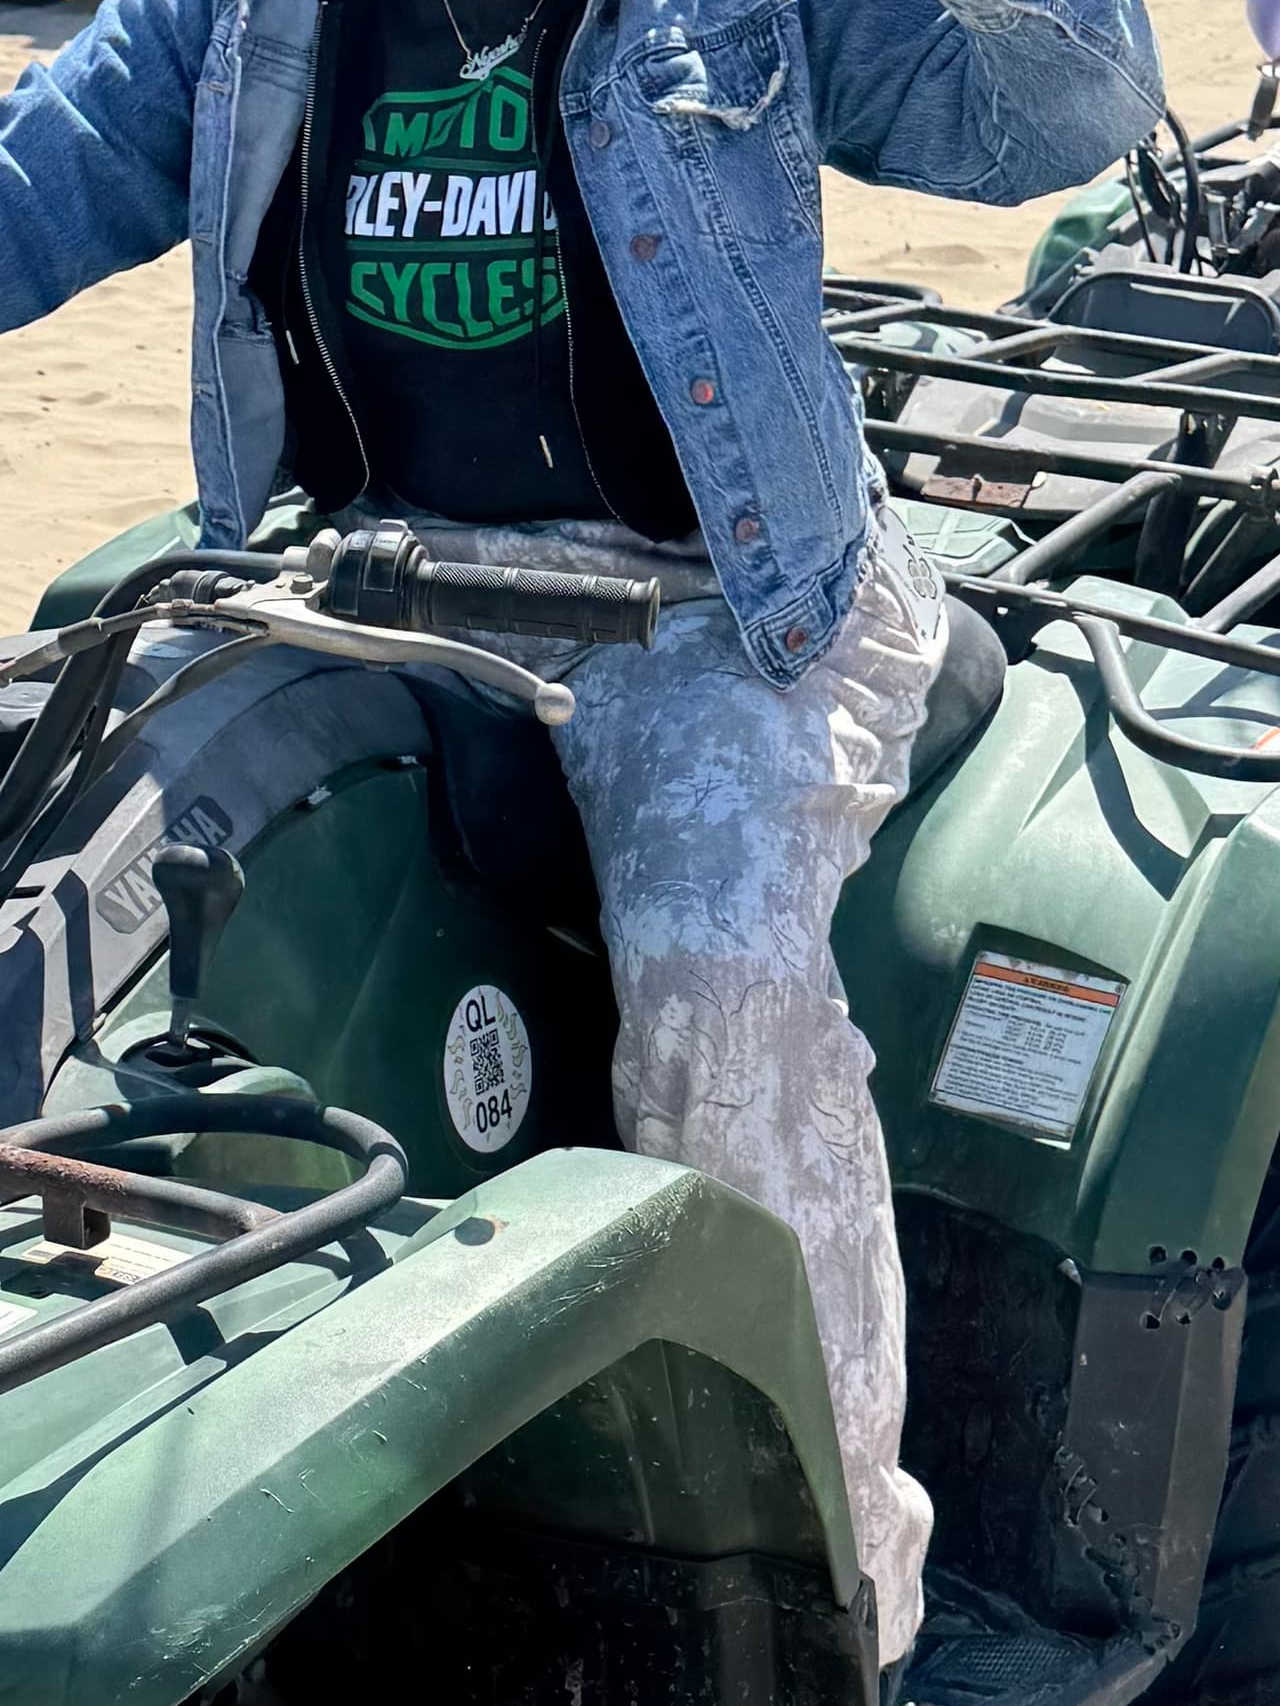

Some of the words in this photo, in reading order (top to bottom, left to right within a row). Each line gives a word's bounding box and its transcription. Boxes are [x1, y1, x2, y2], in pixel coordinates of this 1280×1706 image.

[350, 256, 557, 339] CYCLES
[104, 805, 228, 921] YAHA
[465, 995, 496, 1033] QL
[475, 1089, 513, 1134] 084
